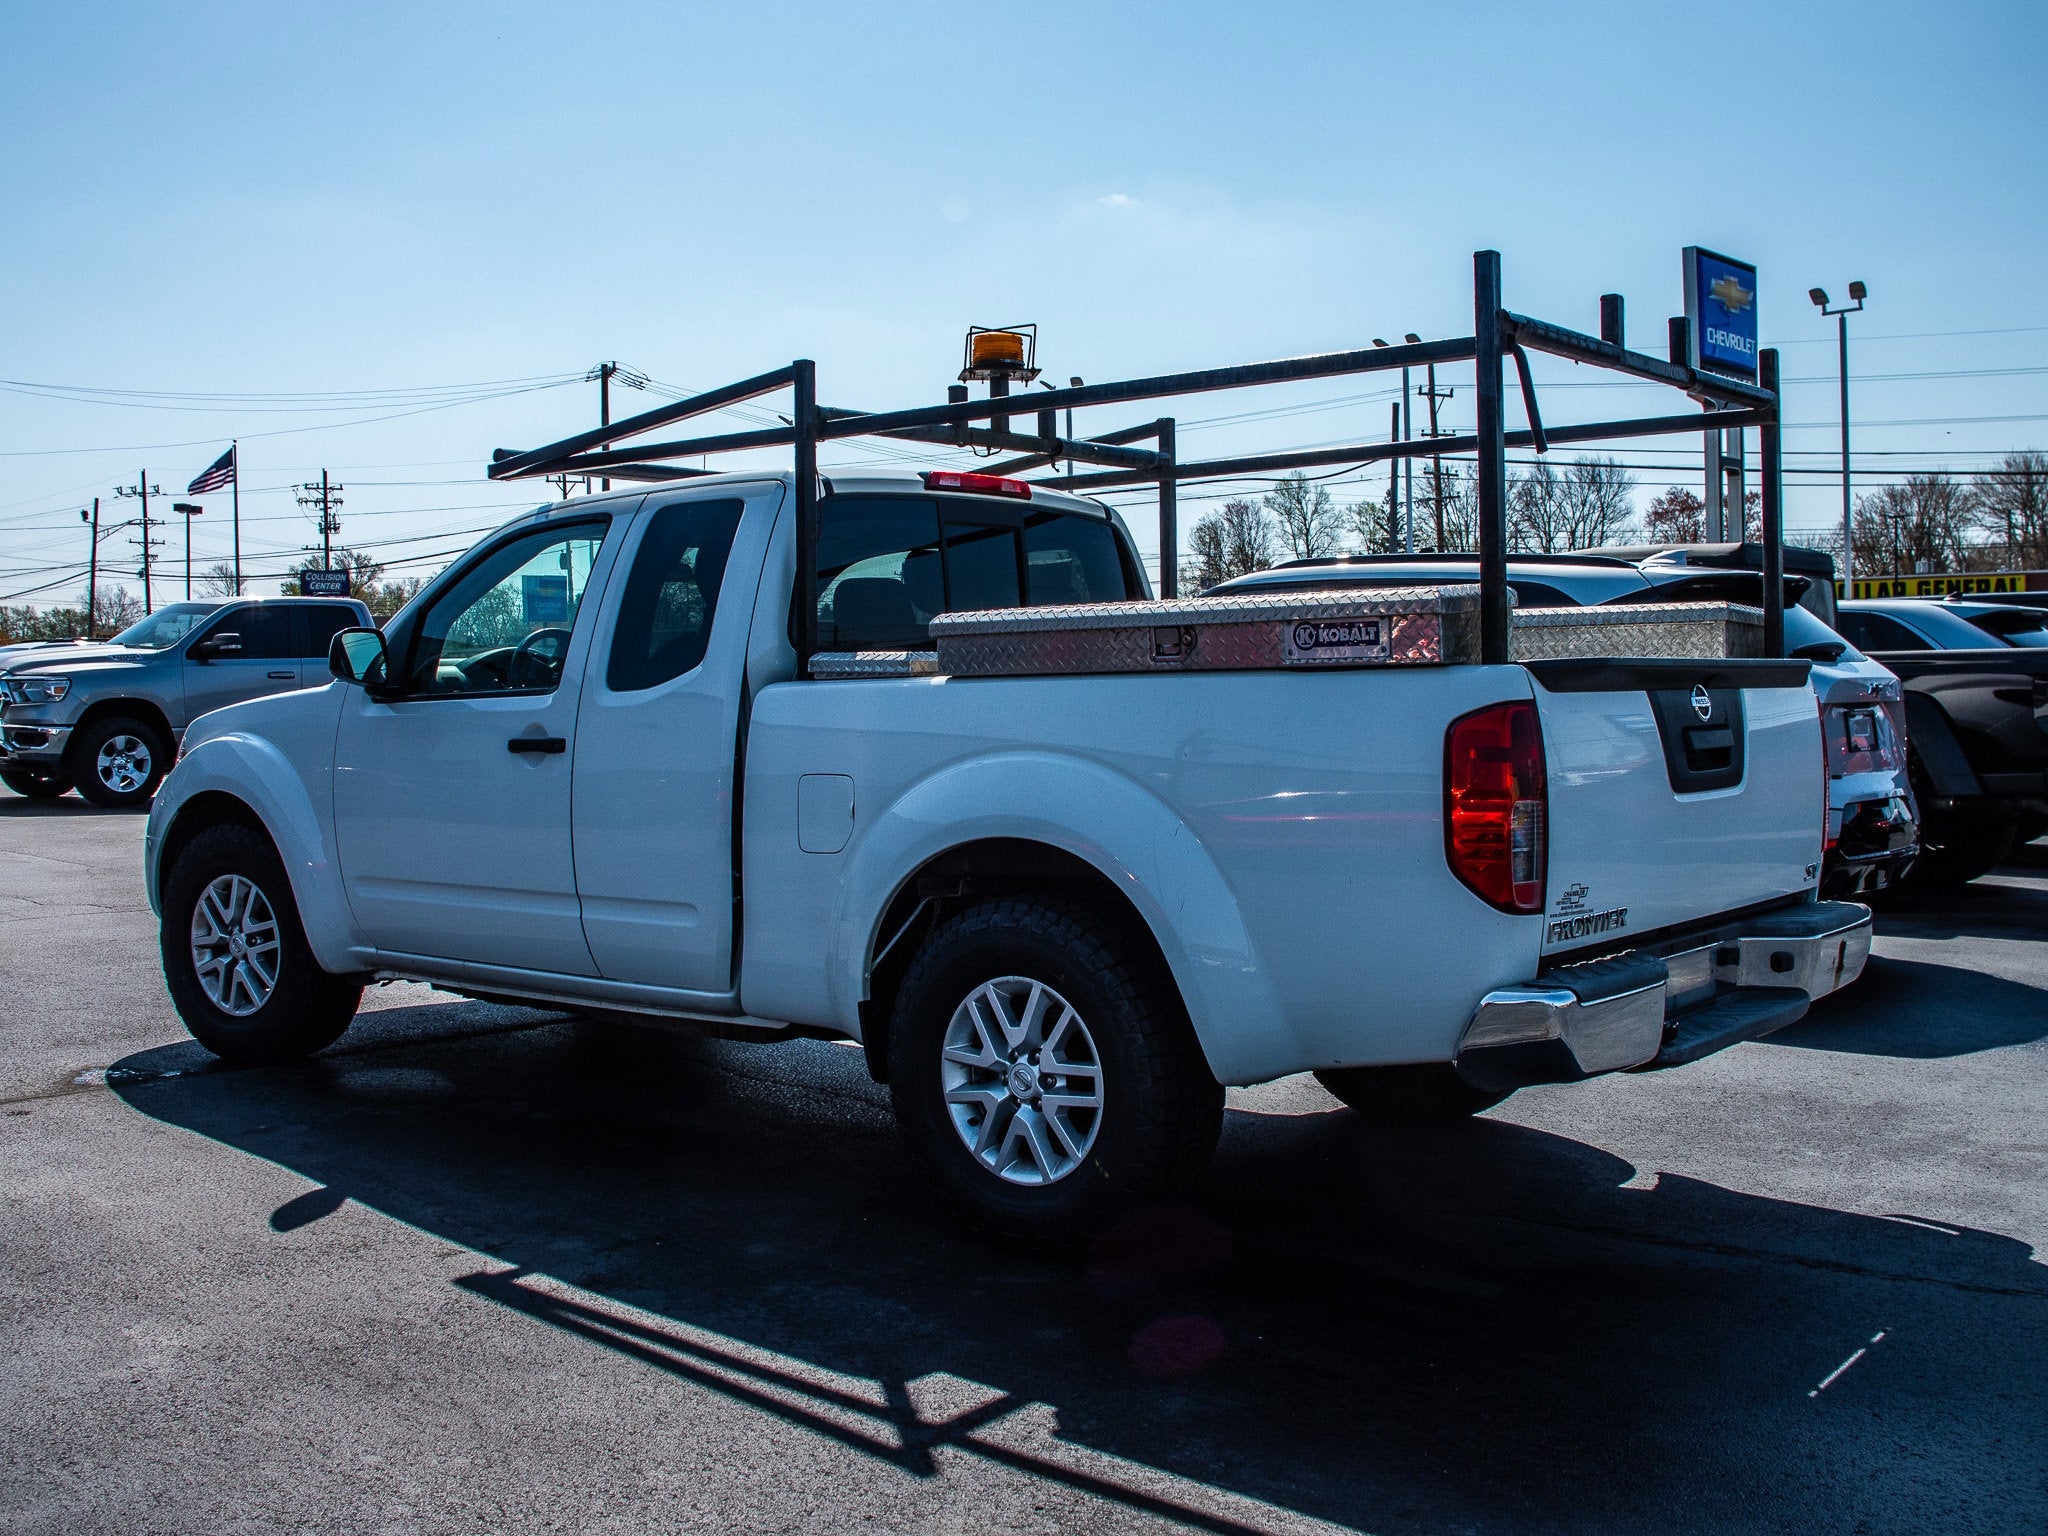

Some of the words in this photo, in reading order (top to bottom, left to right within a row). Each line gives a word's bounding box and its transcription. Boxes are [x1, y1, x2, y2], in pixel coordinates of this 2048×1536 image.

[1707, 327, 1755, 355] CHEVROLET
[305, 572, 347, 581] COLLISION
[310, 582, 341, 590] CENTER
[1318, 626, 1377, 642] KOBALT
[1547, 907, 1628, 944] FRONTIER
